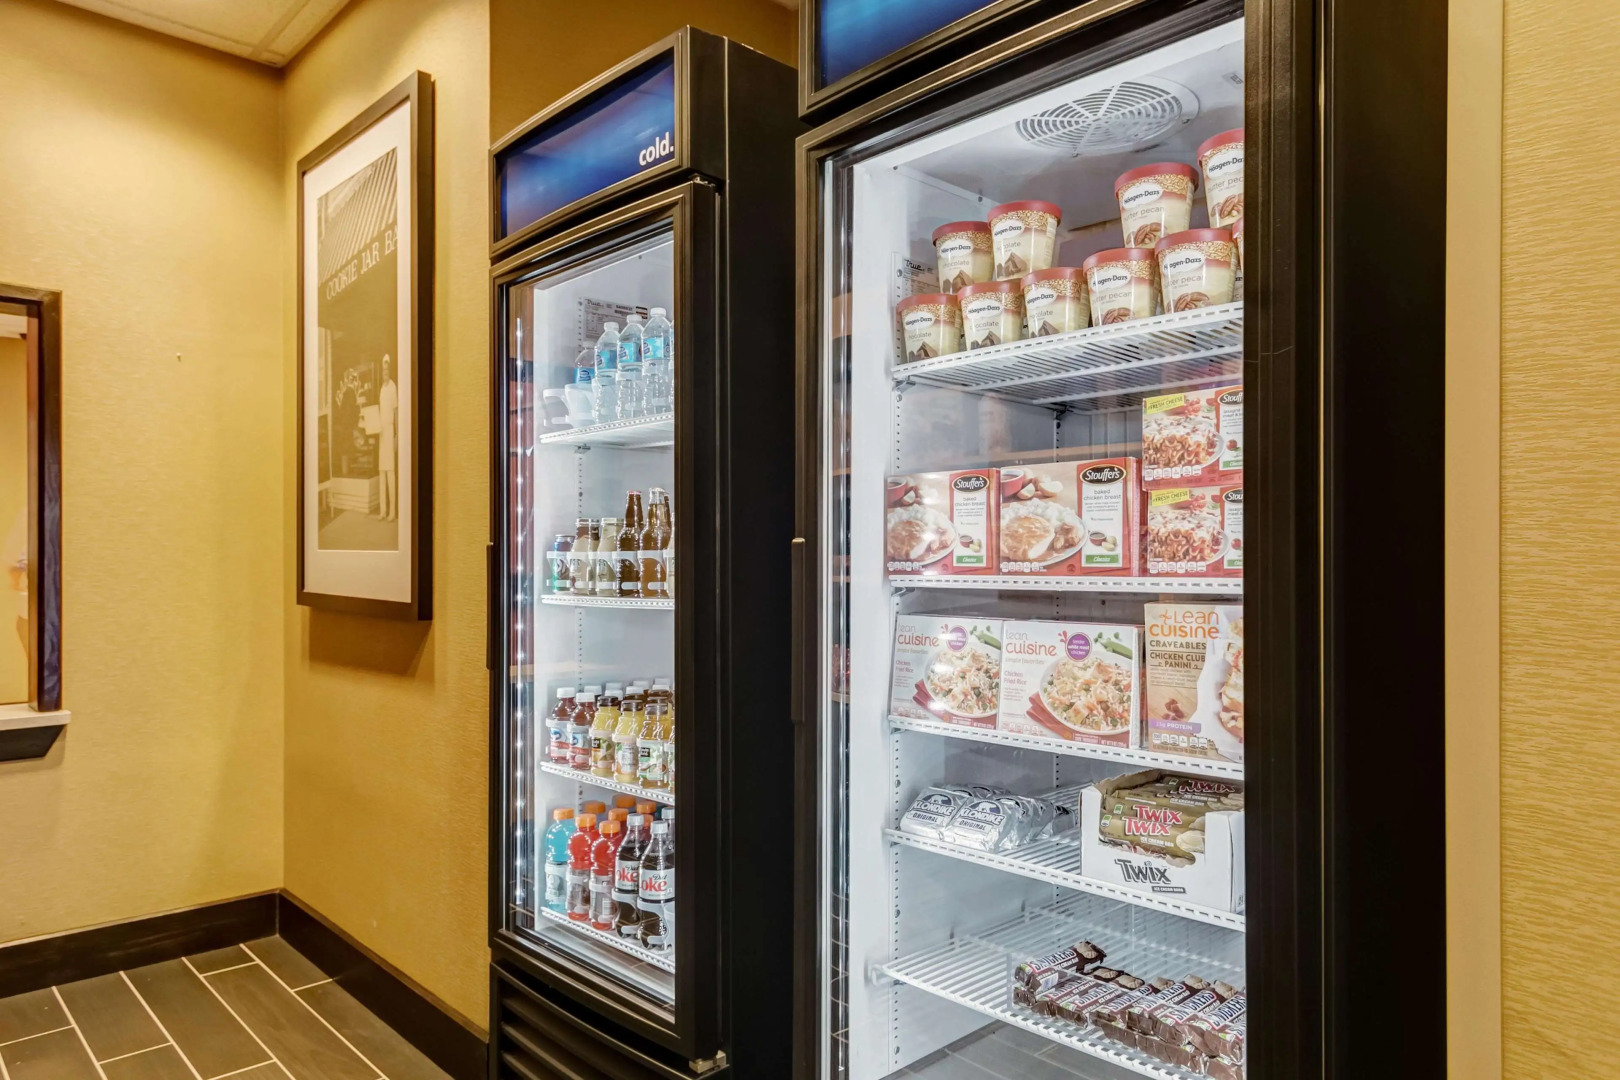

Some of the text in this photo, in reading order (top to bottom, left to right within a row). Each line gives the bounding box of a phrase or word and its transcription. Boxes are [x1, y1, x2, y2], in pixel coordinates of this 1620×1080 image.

[639, 131, 674, 166] cold.
[326, 259, 358, 300] COOKIE
[361, 242, 380, 275] JAR
[1163, 257, 1202, 270] Hagen-Dazs
[1086, 467, 1121, 482] Stouffer's
[955, 476, 985, 490] Stouffer's
[1174, 610, 1219, 625] Lean
[898, 624, 916, 633] lean
[1005, 630, 1028, 640] lean
[897, 632, 940, 647] cuisine
[1149, 640, 1207, 650] CRAVEABLES
[1005, 642, 1057, 657] cuisine
[1150, 652, 1206, 662] CHICKEN CLUB
[1164, 660, 1192, 669] PANINI
[1167, 722, 1193, 730] PROTEIN
[913, 800, 956, 816] KLONDIKE
[1132, 804, 1183, 825] Twix
[912, 812, 939, 823] ORIGINAL
[959, 808, 1004, 825] KLONDIKE
[959, 819, 987, 831] ORIGINAL
[1122, 816, 1172, 835] Twix
[1114, 858, 1172, 885] Twix
[1032, 949, 1076, 971] SNICKERS
